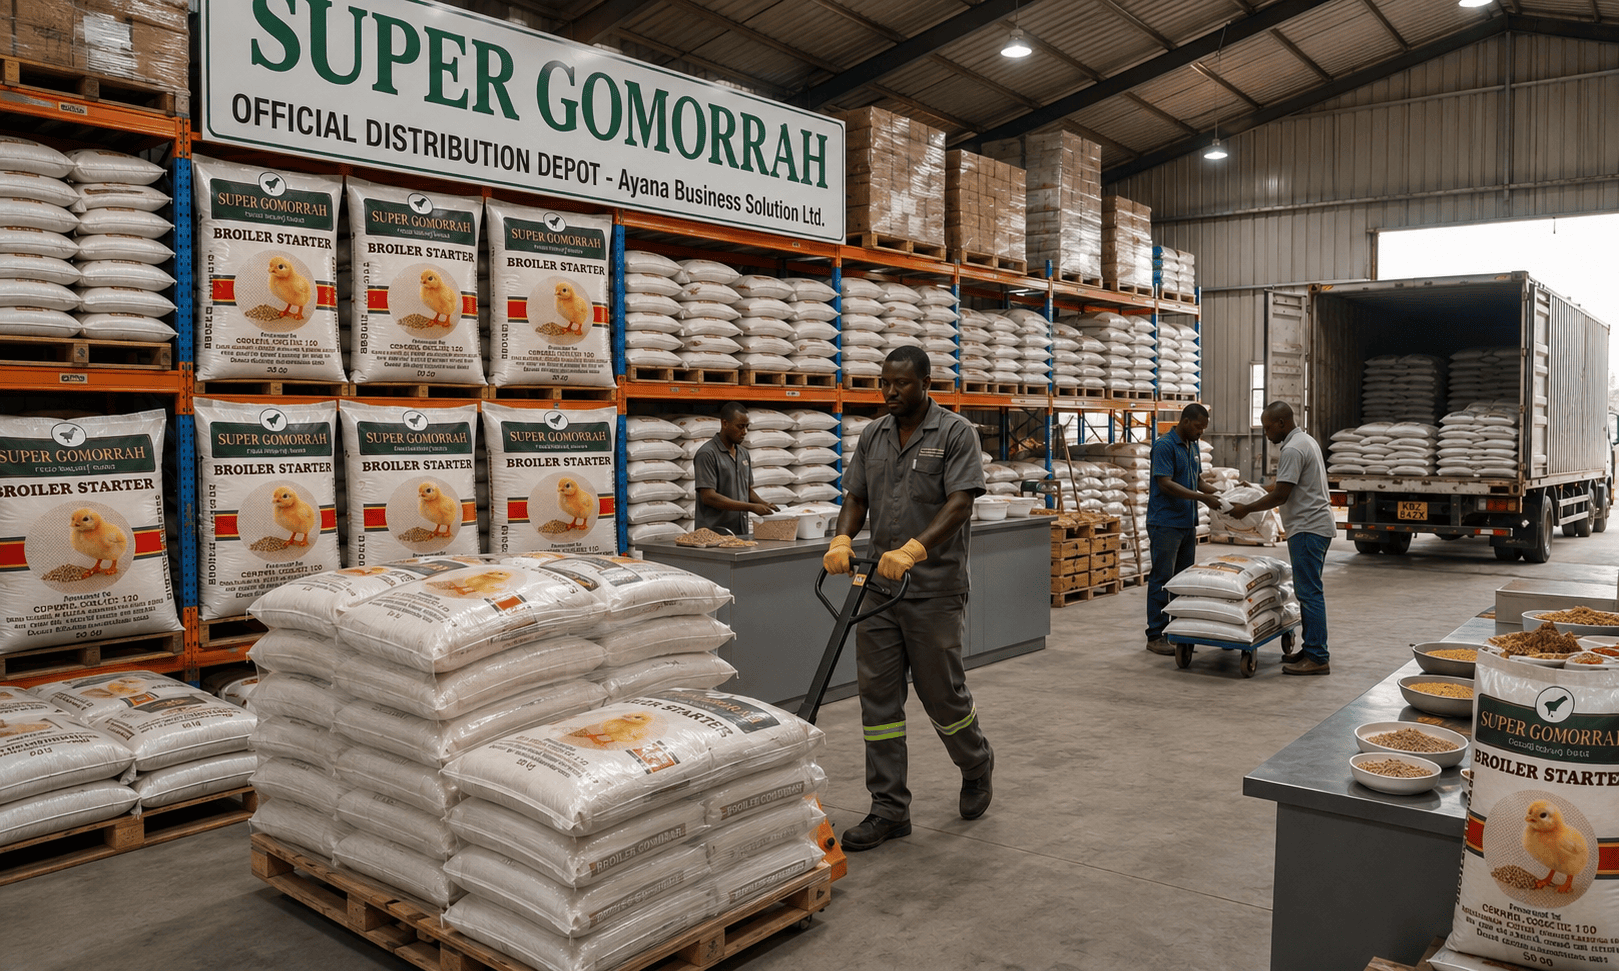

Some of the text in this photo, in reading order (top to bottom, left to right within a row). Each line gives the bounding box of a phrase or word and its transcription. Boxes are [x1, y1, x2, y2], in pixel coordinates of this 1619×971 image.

[251, 0, 828, 189] SUPER GOMORRAH
[232, 93, 357, 143] OFFICIAL
[366, 119, 530, 174] DISTRIBUTION
[538, 152, 600, 186] DEPOT
[618, 168, 669, 198] Ayana
[675, 180, 741, 211] Business
[746, 194, 799, 222] Solution
[802, 204, 825, 227] Ltd.
[218, 192, 327, 216] SUPER GOMORRAH
[372, 210, 409, 226] SUPER
[411, 215, 471, 233] GOMORRAH
[213, 227, 332, 249] BROILER STARTER
[511, 228, 601, 248] SUPER GOMORRAH
[368, 243, 475, 262] BROILER STARTER
[507, 257, 605, 275] BROILER STARTER
[218, 432, 327, 445] SUPER GOMORRAH
[366, 432, 467, 443] SUPER GOMORRAH
[510, 431, 606, 442] SUPER GOMORRAH
[55, 446, 146, 462] GOMORRAH
[506, 456, 611, 468] BROILER STARTER
[213, 462, 332, 476] BROILER STARTER
[362, 459, 472, 472] BROILER STARTER
[0, 478, 155, 498] ROILER STARTER
[1481, 710, 1619, 746] SUPER GOMORRA
[1474, 749, 1538, 780] BROILER
